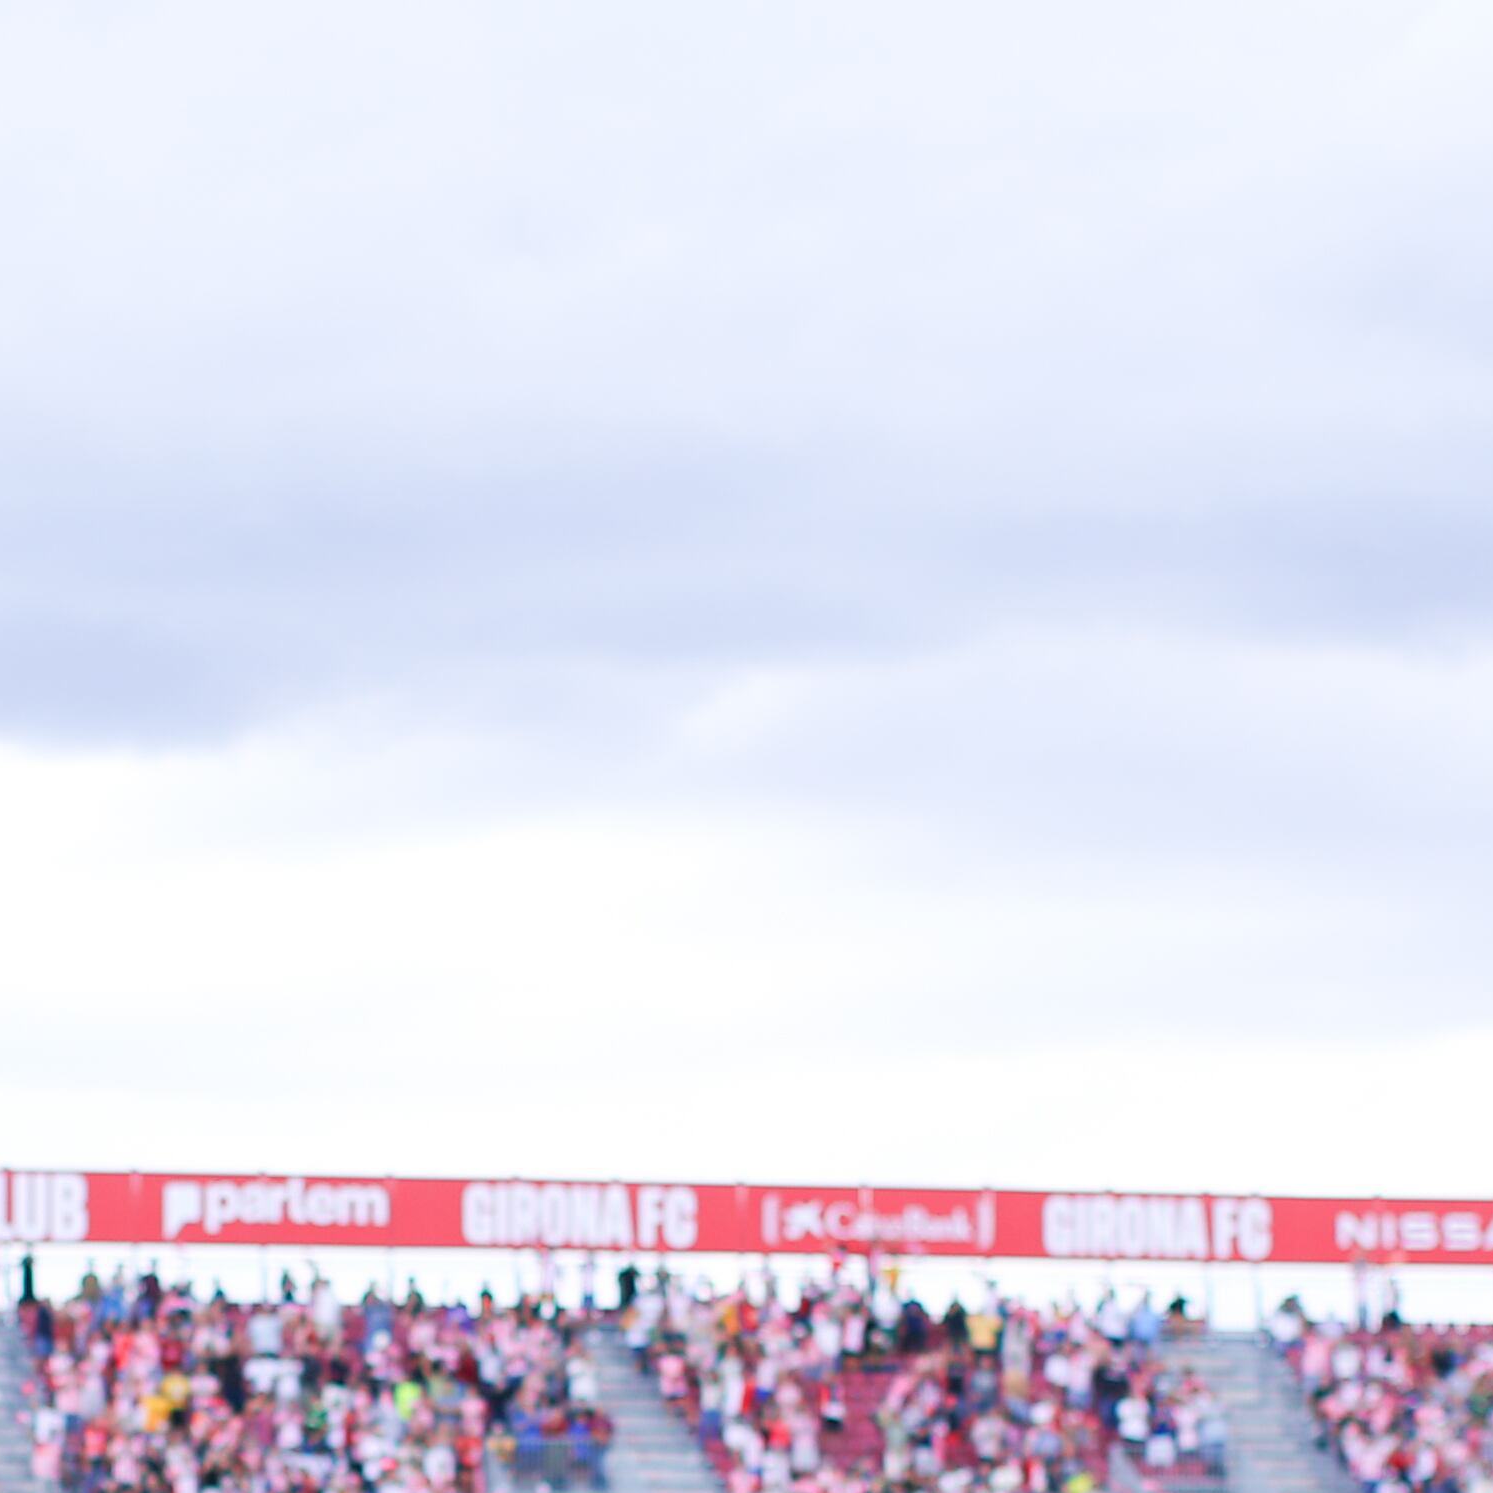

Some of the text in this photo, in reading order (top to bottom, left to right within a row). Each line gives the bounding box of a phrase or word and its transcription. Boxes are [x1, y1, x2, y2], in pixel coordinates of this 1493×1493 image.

[203, 1177, 390, 1235] parlem
[461, 1181, 698, 1250] GIRONA FC
[1042, 1193, 1273, 1262] GIRONA FC
